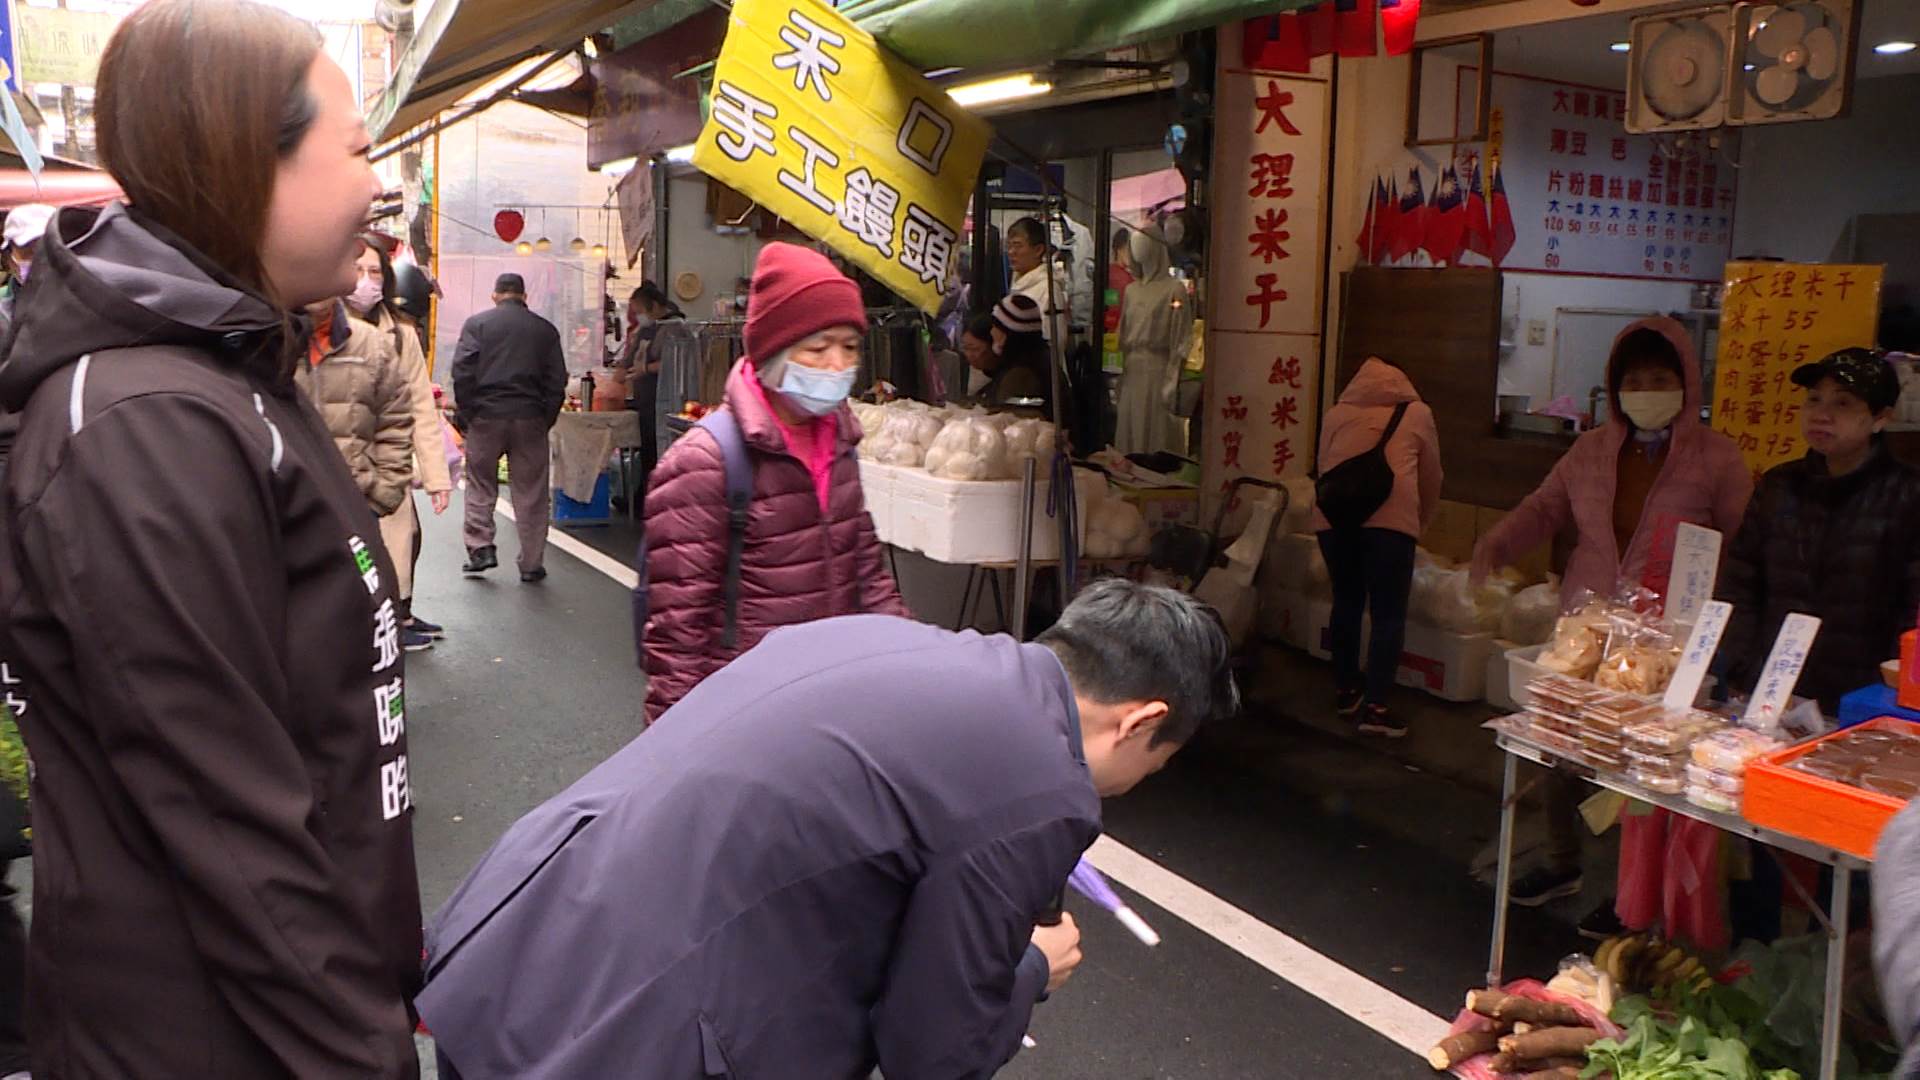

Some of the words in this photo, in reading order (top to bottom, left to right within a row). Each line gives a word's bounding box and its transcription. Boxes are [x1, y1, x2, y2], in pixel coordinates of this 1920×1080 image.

[711, 79, 957, 295] 手工饅頭
[1246, 80, 1302, 328] 大理米干
[1544, 217, 1564, 232] 120
[1568, 219, 1582, 232] 50
[1737, 267, 1855, 301] 大理米干
[1730, 304, 1772, 332] 米干
[1783, 310, 1820, 330] 55
[1778, 339, 1810, 363] 65
[1772, 401, 1801, 425] 95
[1766, 432, 1796, 456] 95
